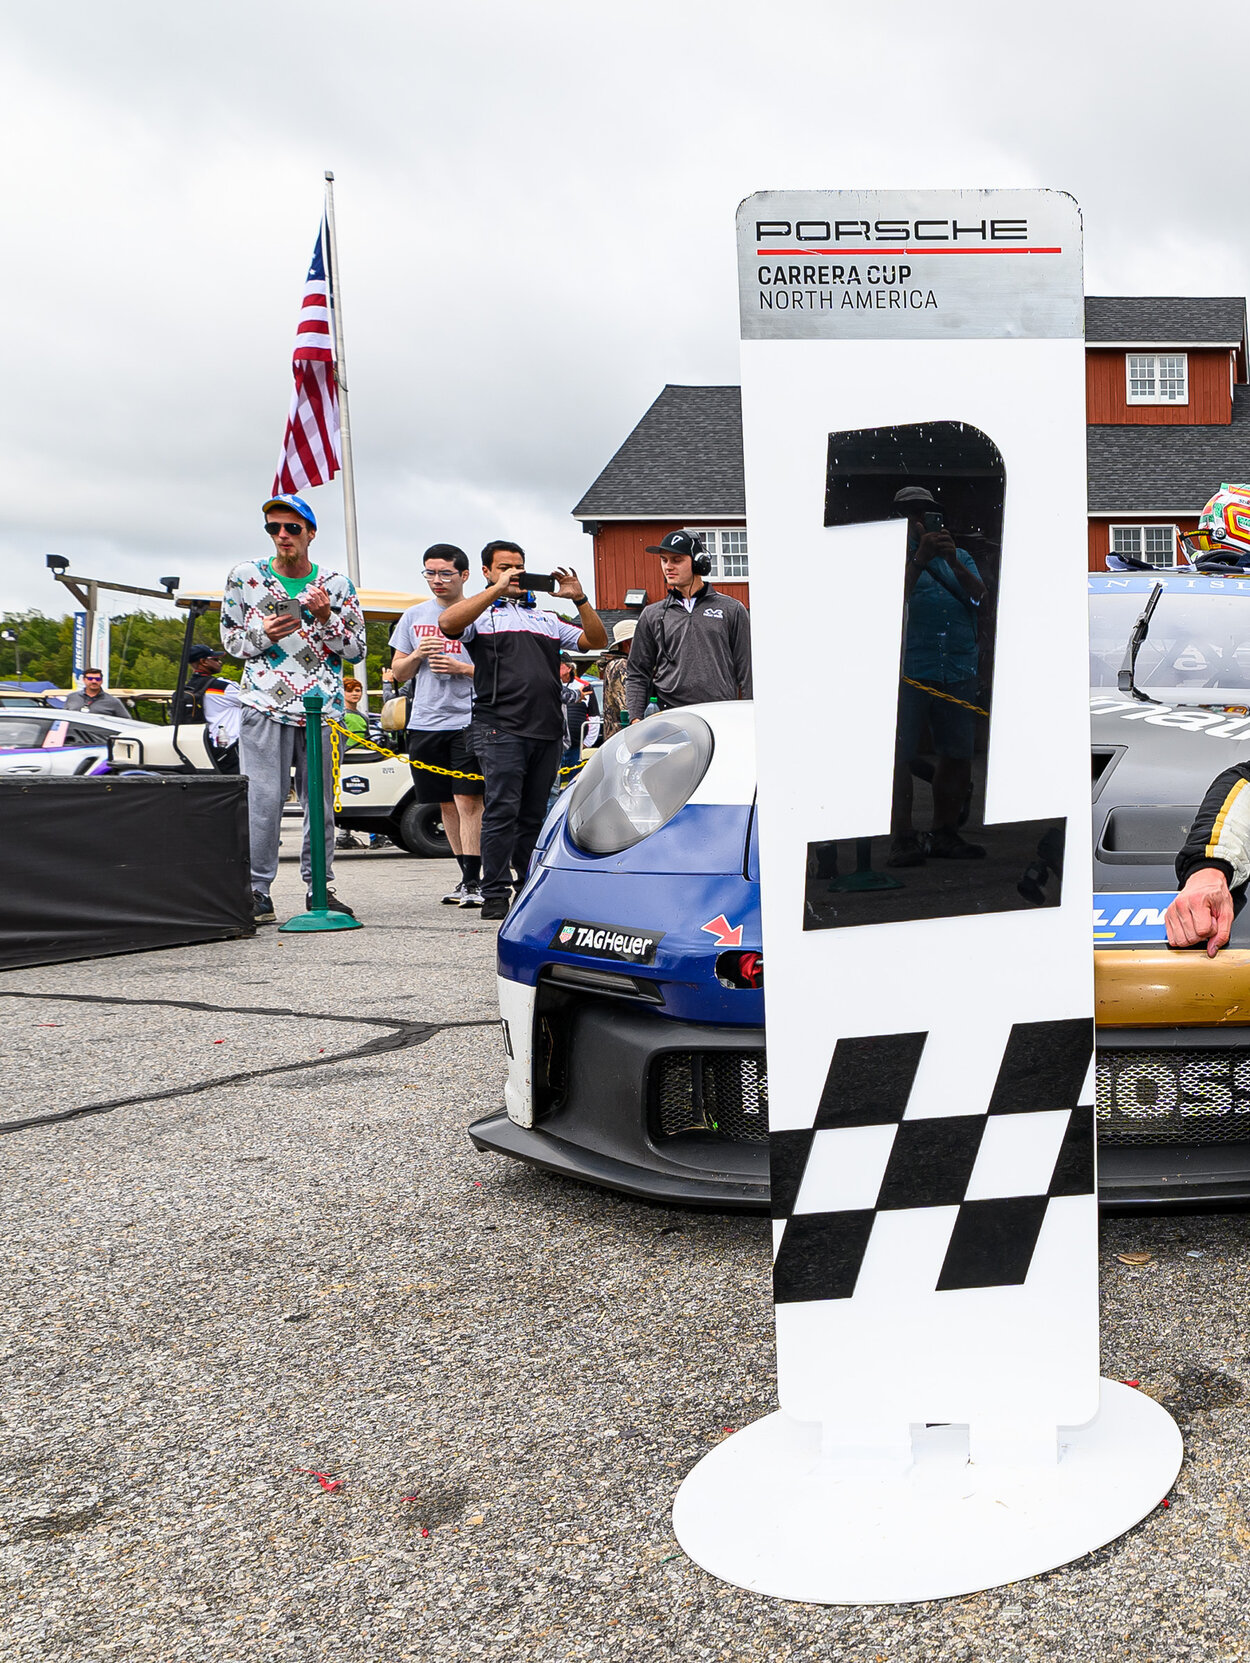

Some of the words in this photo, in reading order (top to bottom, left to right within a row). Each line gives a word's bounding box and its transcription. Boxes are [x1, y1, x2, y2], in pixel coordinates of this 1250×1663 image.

[755, 219, 1028, 242] PORSCHE
[757, 265, 862, 285] CARRERA
[867, 265, 912, 285] CUP
[759, 290, 833, 309] NORTH
[841, 289, 938, 309] AMERICA
[803, 420, 1068, 931] 1
